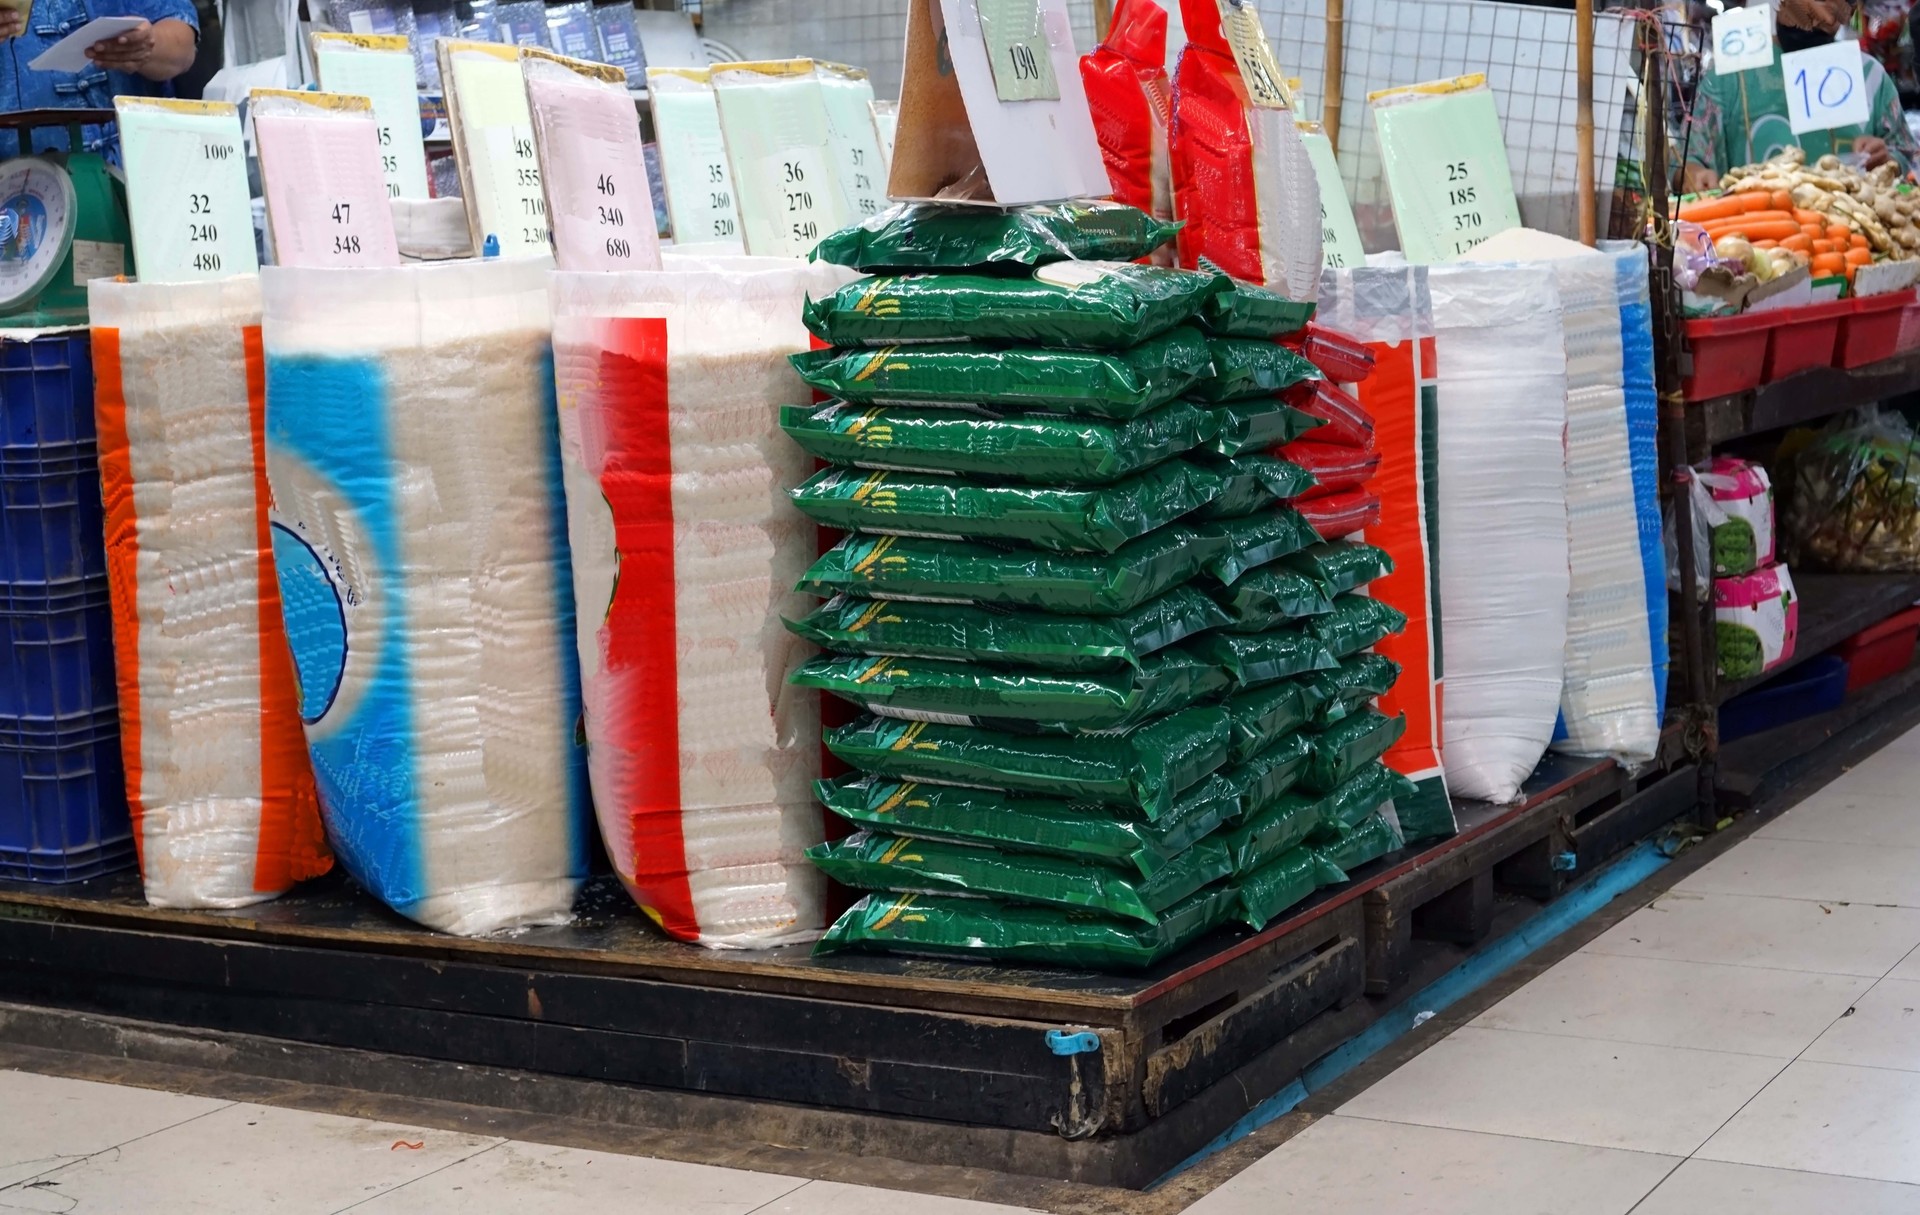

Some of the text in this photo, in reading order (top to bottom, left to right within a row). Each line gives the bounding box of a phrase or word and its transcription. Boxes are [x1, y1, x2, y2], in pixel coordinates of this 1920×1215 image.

[1721, 25, 1767, 56] 65
[1008, 45, 1039, 80] 190
[1794, 66, 1853, 119] 10
[516, 139, 532, 158] 48
[852, 148, 864, 166] 37
[517, 168, 539, 187] 355
[708, 164, 723, 183] 35
[784, 161, 804, 183] 36
[1446, 162, 1468, 181] 25
[386, 183, 400, 199] 70
[597, 173, 615, 196] 46
[190, 193, 211, 214] 32
[711, 192, 730, 209] 260
[787, 191, 812, 212] 270
[1450, 187, 1477, 206] 185
[332, 203, 350, 224] 47
[522, 198, 545, 215] 710
[598, 206, 624, 227] 340
[1453, 212, 1482, 231] 370
[190, 224, 218, 242] 240
[523, 228, 549, 244] 2,30
[714, 219, 734, 236] 520
[793, 221, 817, 242] 540
[1322, 227, 1337, 243] 08
[333, 235, 361, 254] 348
[606, 238, 631, 259] 680
[1455, 235, 1489, 255] 1,2
[193, 253, 221, 271] 480
[1327, 253, 1345, 268] 415
